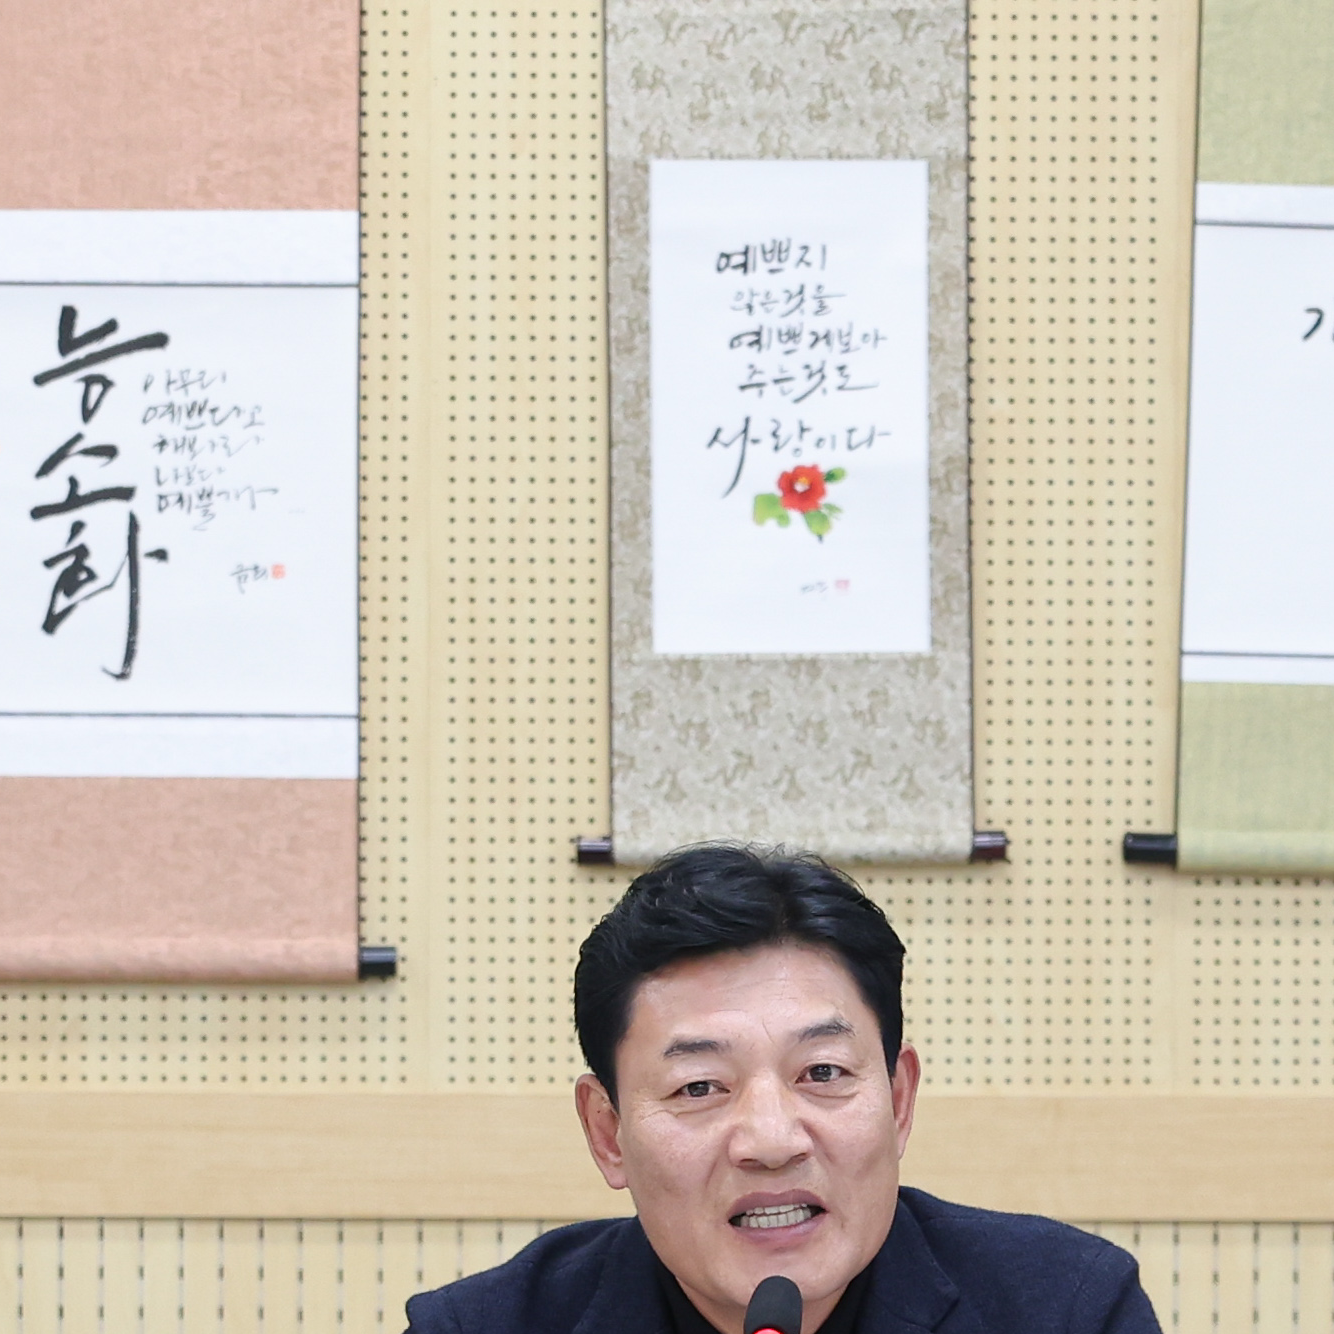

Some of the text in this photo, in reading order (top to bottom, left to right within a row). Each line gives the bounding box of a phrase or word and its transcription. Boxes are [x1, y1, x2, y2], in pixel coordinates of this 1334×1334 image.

[716, 238, 827, 276] 예쁘지
[31, 305, 168, 681] 능소화
[706, 415, 891, 500] 사랑이다
